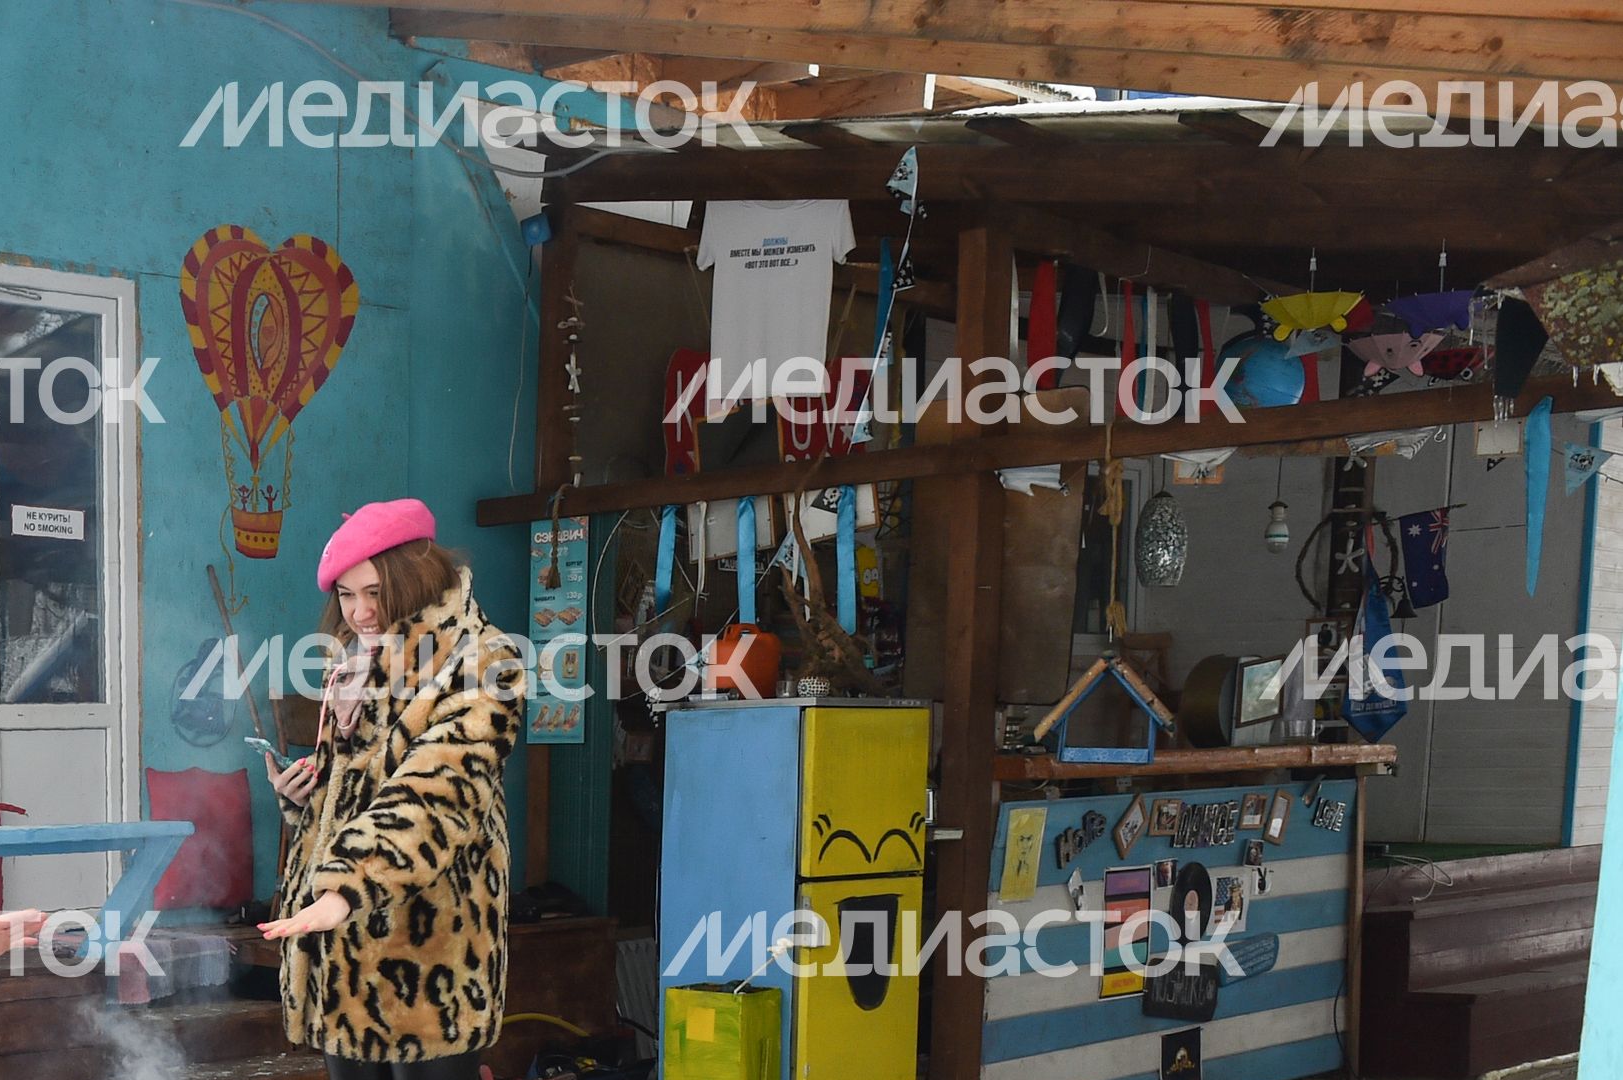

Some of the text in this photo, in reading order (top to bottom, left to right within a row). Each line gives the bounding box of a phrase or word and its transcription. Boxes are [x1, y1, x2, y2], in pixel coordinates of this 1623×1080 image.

[729, 244, 816, 258] ВМЕСТЕ МЫ МОЖЕМ ИЗМЕНИТЬ
[758, 259, 769, 269] ЭТО
[769, 258, 780, 268] ВОТ
[26, 511, 71, 523] НЕ КУРИТЬ!
[23, 522, 73, 535] NO SMOKING
